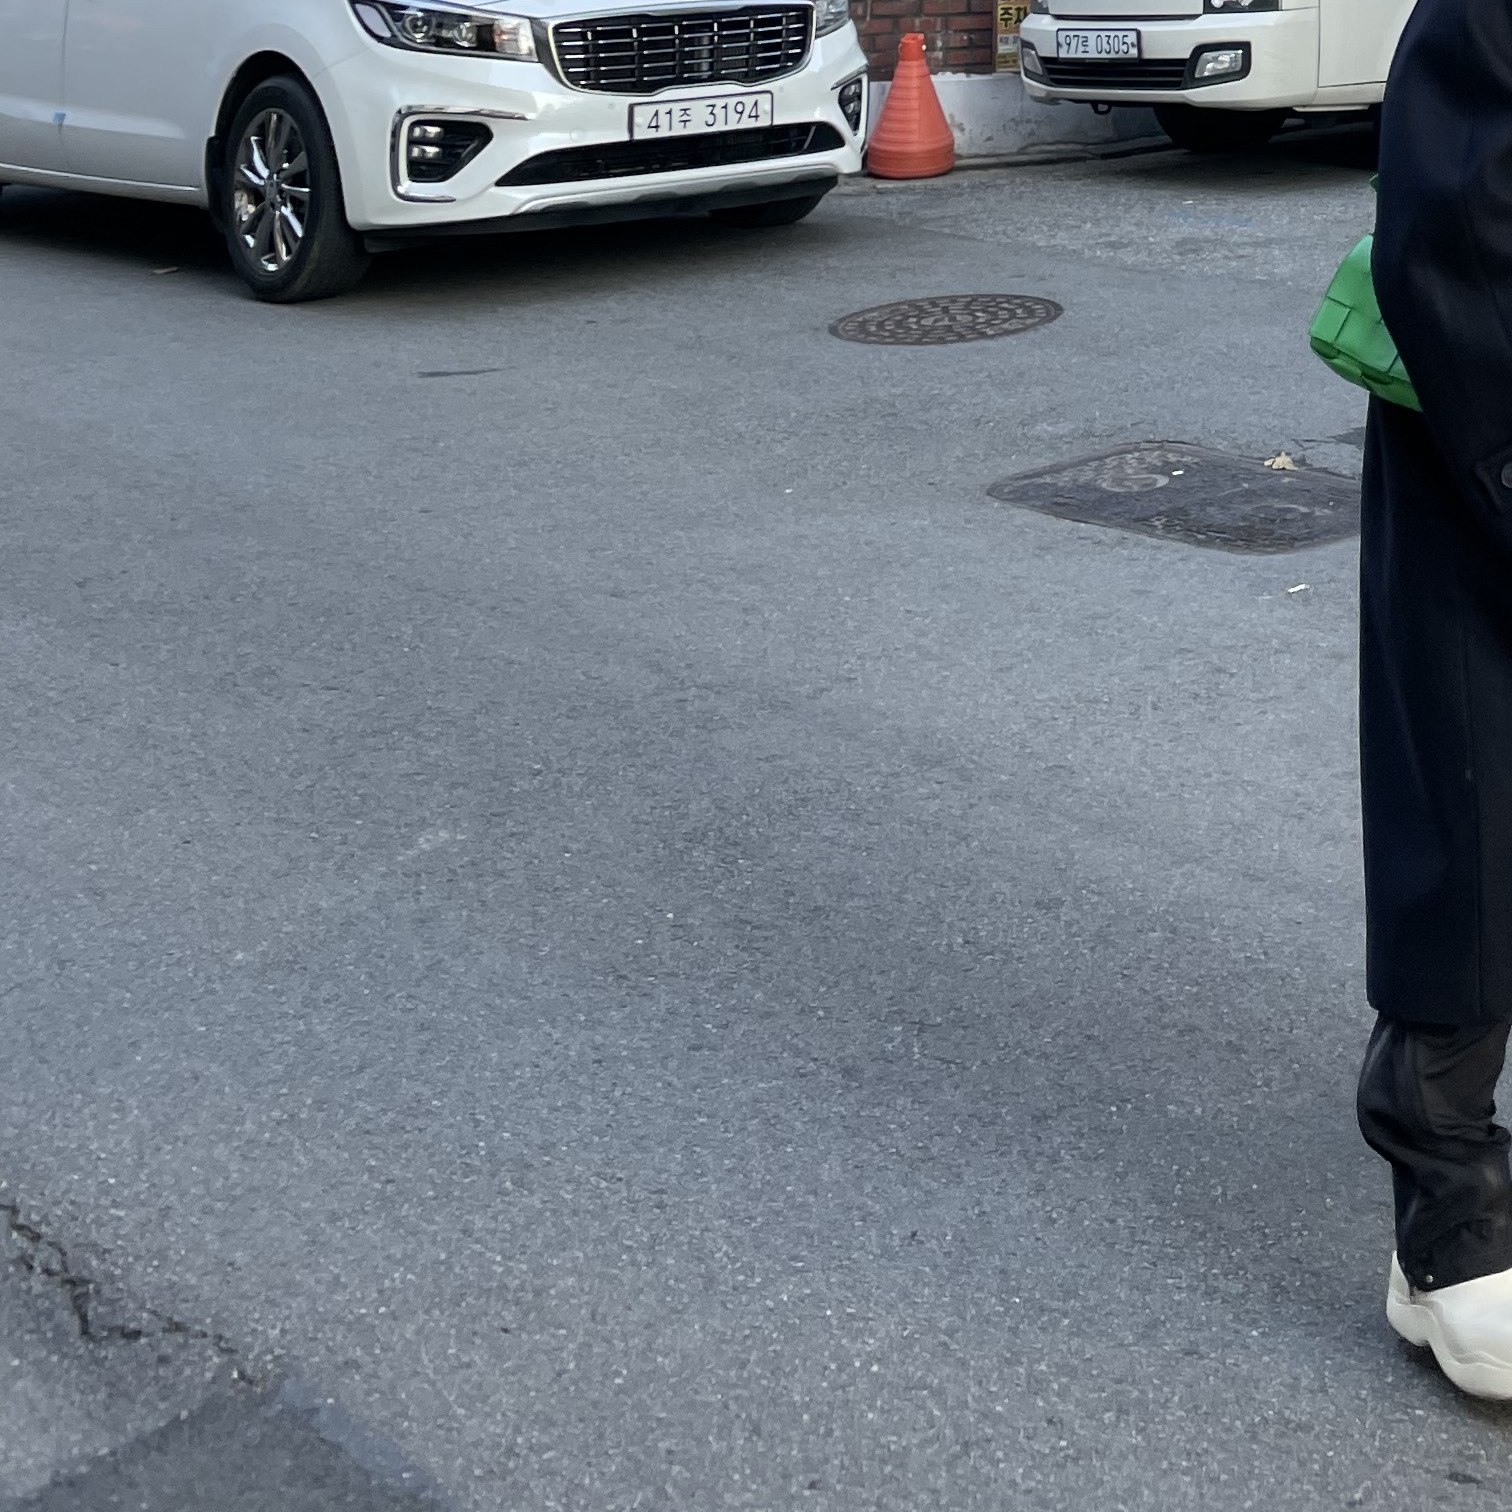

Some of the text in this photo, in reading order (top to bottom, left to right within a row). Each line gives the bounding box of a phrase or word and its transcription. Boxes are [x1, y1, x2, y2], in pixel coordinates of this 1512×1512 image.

[1064, 34, 1130, 55] 97로 0305
[646, 99, 761, 133] 41주 3194
